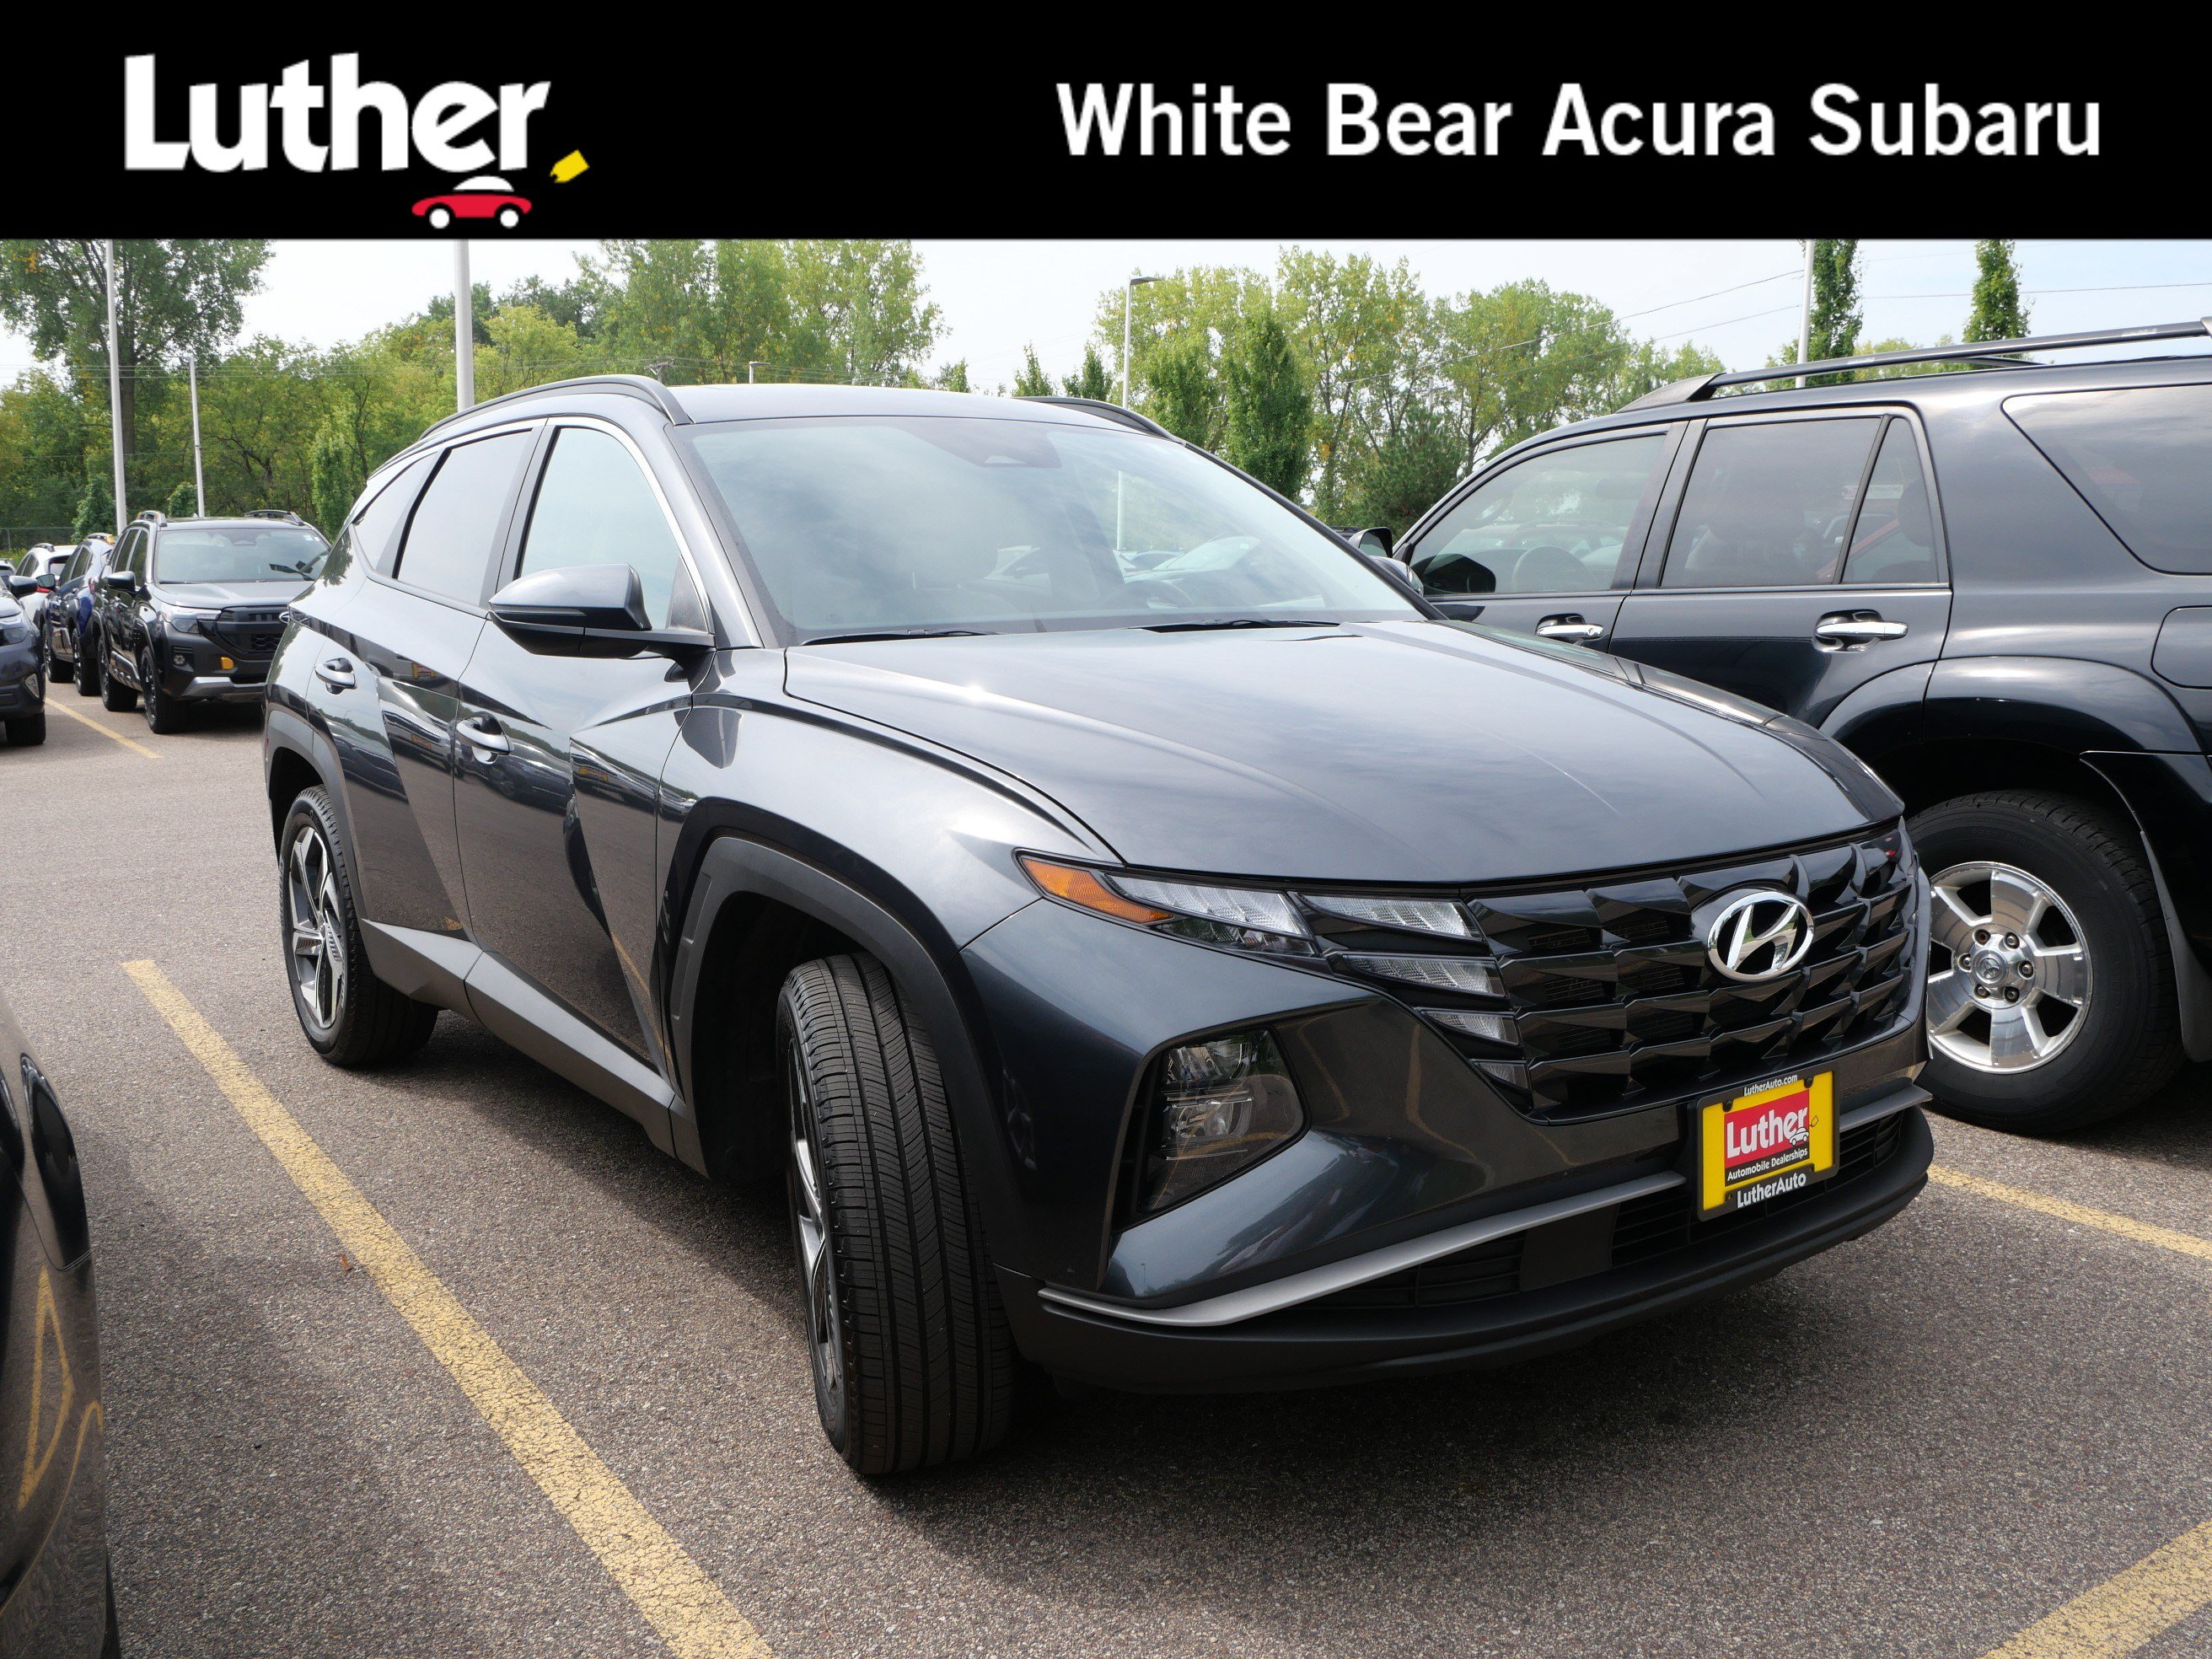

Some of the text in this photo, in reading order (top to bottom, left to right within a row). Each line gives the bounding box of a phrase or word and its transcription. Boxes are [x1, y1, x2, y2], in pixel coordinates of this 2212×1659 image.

[1743, 1075, 1797, 1096] LutherAuto.com
[1726, 1107, 1808, 1158] Luther
[1727, 1147, 1808, 1181] Automobile Dealerships
[1737, 1173, 1807, 1208] LutherAuto
